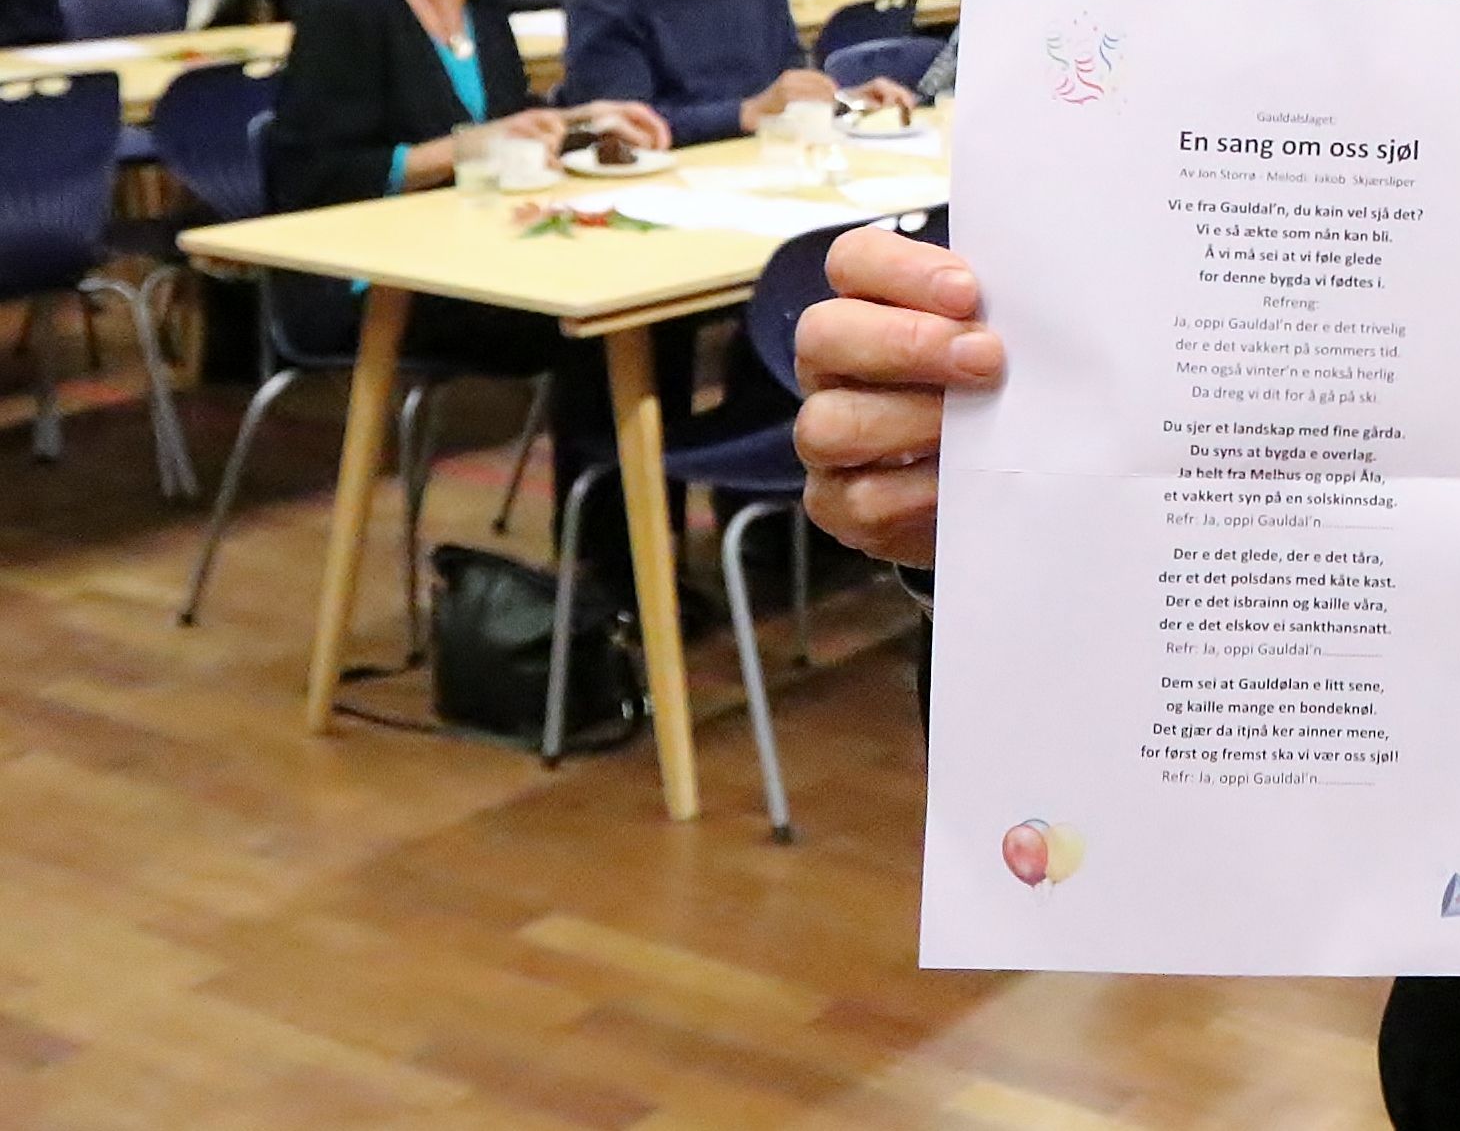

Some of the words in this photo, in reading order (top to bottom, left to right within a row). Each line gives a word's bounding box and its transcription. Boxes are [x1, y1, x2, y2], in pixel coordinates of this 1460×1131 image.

[1179, 130, 1208, 152] En
[1216, 137, 1275, 160] sang
[1281, 139, 1321, 157] om
[1329, 141, 1369, 159] oss
[1376, 138, 1419, 165] sjøl
[1167, 198, 1182, 211] Vi
[1184, 202, 1194, 212] e
[1197, 199, 1217, 213] fra
[1293, 204, 1311, 217] du
[1314, 204, 1344, 218] kain
[1346, 206, 1368, 219] vel
[1393, 207, 1424, 221] det?
[1196, 223, 1210, 236] Vi
[1212, 226, 1222, 236] e
[1225, 223, 1240, 237] så
[1282, 229, 1311, 240] som
[1343, 228, 1369, 242] kan
[1372, 229, 1393, 243] bli.
[1218, 246, 1230, 260] vi
[1233, 246, 1255, 261] må
[1258, 249, 1278, 262] sei
[1281, 250, 1296, 262] at
[1299, 250, 1311, 263] vi
[1315, 249, 1342, 265] føle
[1344, 251, 1382, 268] glede
[1198, 269, 1220, 282] for
[1222, 269, 1266, 284] denne
[1269, 271, 1311, 288] bygda
[1314, 273, 1327, 287] vi
[1330, 273, 1374, 289] fødtes
[1195, 318, 1224, 332] oppi
[1295, 318, 1319, 333] der
[1321, 323, 1331, 334] e
[1333, 320, 1356, 334] det
[1359, 321, 1406, 338] trivelig
[1175, 337, 1199, 351] der
[1201, 340, 1211, 352] e
[1213, 338, 1236, 354] det
[1240, 340, 1290, 355] vakkert
[1291, 341, 1312, 358] på
[1313, 342, 1376, 358] sommers
[1176, 360, 1208, 375] Men
[1210, 361, 1242, 378] også
[1301, 368, 1311, 379] e
[1313, 365, 1353, 380] nokså
[1191, 385, 1210, 398] Da
[1211, 385, 1245, 403] dreg
[1247, 387, 1260, 400] vi
[1262, 386, 1281, 401] dit
[1284, 388, 1305, 402] for
[1318, 388, 1336, 405] gå
[1338, 389, 1356, 406] på
[1162, 419, 1182, 432] Du
[1186, 420, 1212, 436] sjer
[1214, 422, 1230, 434] et
[1233, 421, 1296, 439] landskap
[1298, 424, 1330, 437] med
[1332, 424, 1360, 438] fine
[1190, 444, 1210, 457] Du
[1212, 446, 1243, 460] syns
[1246, 446, 1261, 458] at
[1264, 445, 1306, 462] bygda
[1309, 449, 1319, 460] e
[1321, 447, 1377, 464] overlag.
[1177, 466, 1192, 479] Ja
[1195, 466, 1224, 479] helt
[1225, 466, 1248, 480] fra
[1249, 468, 1302, 481] Melhus
[1304, 471, 1322, 485] og
[1324, 469, 1356, 485] oppi
[1163, 490, 1178, 502] et
[1181, 488, 1234, 503] vakkert
[1237, 493, 1262, 506] syn
[1264, 490, 1282, 506] på
[1285, 494, 1303, 504] en
[1306, 491, 1397, 509] solskinnsdag.
[1173, 547, 1199, 561] Der
[1201, 550, 1210, 561] e
[1214, 548, 1237, 561] det
[1240, 548, 1283, 564] glede,
[1286, 548, 1310, 563] der
[1312, 553, 1322, 563] e
[1324, 550, 1348, 564] det
[1352, 550, 1384, 567] tåra,
[1158, 570, 1182, 584] der
[1185, 572, 1200, 584] et
[1203, 570, 1227, 585] det
[1230, 571, 1292, 587] polsdans
[1295, 572, 1326, 586] med
[1329, 573, 1360, 588] kåte
[1363, 574, 1396, 588] kast.
[1165, 594, 1191, 608] Der
[1193, 597, 1203, 608] e
[1205, 594, 1230, 609] det
[1233, 595, 1289, 609] isbrainn
[1292, 598, 1310, 612] og
[1312, 596, 1350, 611] kaille
[1353, 597, 1387, 614] våra,
[1159, 617, 1183, 630] der
[1186, 620, 1195, 631] e
[1198, 618, 1222, 632] det
[1225, 618, 1270, 632] elskov
[1272, 619, 1286, 632] ei
[1161, 676, 1193, 689] Dem
[1197, 676, 1217, 690] sei
[1219, 678, 1235, 691] at
[1238, 677, 1309, 693] Gauldølan
[1312, 680, 1321, 691] e
[1324, 678, 1344, 692] litt
[1348, 681, 1384, 694] sene,
[1165, 702, 1184, 715] og
[1186, 698, 1224, 714] kaille
[1227, 703, 1275, 717] mange
[1277, 703, 1296, 714] en
[1152, 722, 1177, 736] Det
[1180, 723, 1213, 740] gjær
[1215, 723, 1233, 737] da
[1272, 723, 1295, 738] ker
[1297, 724, 1343, 738] ainner
[1346, 728, 1389, 741] mene,
[1140, 744, 1161, 759] for
[1164, 745, 1197, 760] først
[1200, 750, 1218, 763] og
[1222, 747, 1267, 762] fremst
[1271, 747, 1294, 761] ska
[1297, 748, 1309, 761] vi
[1313, 751, 1341, 762] vær
[1343, 751, 1366, 762] oss
